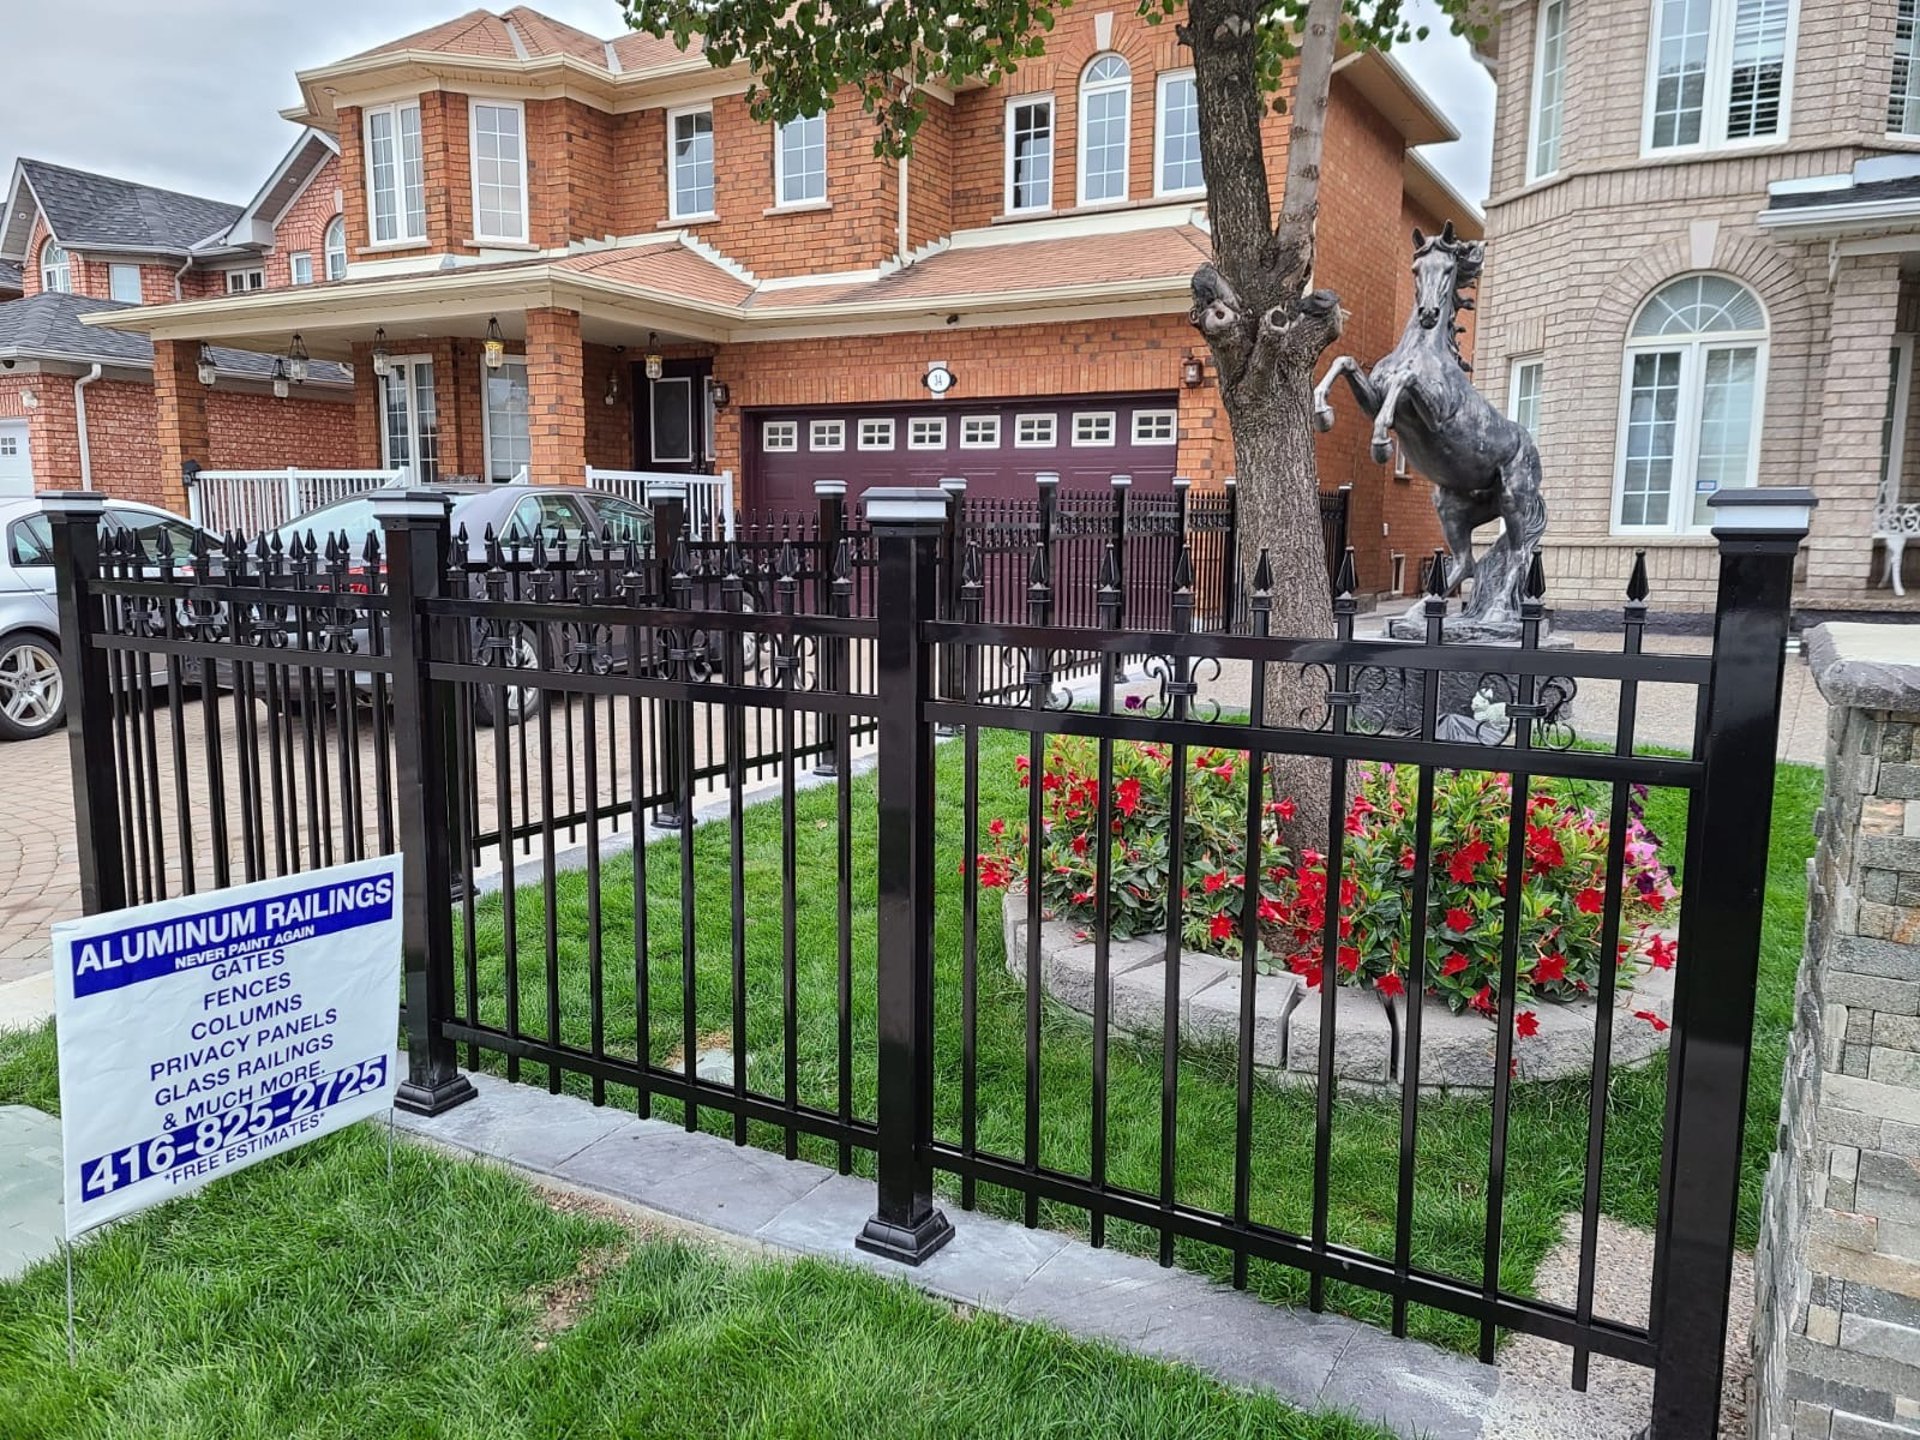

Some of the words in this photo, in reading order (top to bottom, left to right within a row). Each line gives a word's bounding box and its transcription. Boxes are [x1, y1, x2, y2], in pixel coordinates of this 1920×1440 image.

[76, 907, 256, 976] ALUMINUM
[266, 878, 392, 930] RAILINGS
[174, 948, 226, 970] NEVER
[228, 937, 271, 957] PAINT
[273, 924, 315, 945] AGAIN
[203, 972, 292, 1011] FENCES
[211, 949, 285, 981] GATES
[150, 1035, 250, 1081] PRIVACY
[257, 1008, 337, 1047] PANELS
[190, 994, 303, 1040] COLUMNS
[155, 1067, 229, 1107] GLASS
[237, 1033, 334, 1078] RAILINGS
[162, 1113, 178, 1131] &
[185, 1089, 253, 1123] MUCH
[260, 1060, 326, 1097] MORE.
[87, 1059, 384, 1194] 416-825-2725
